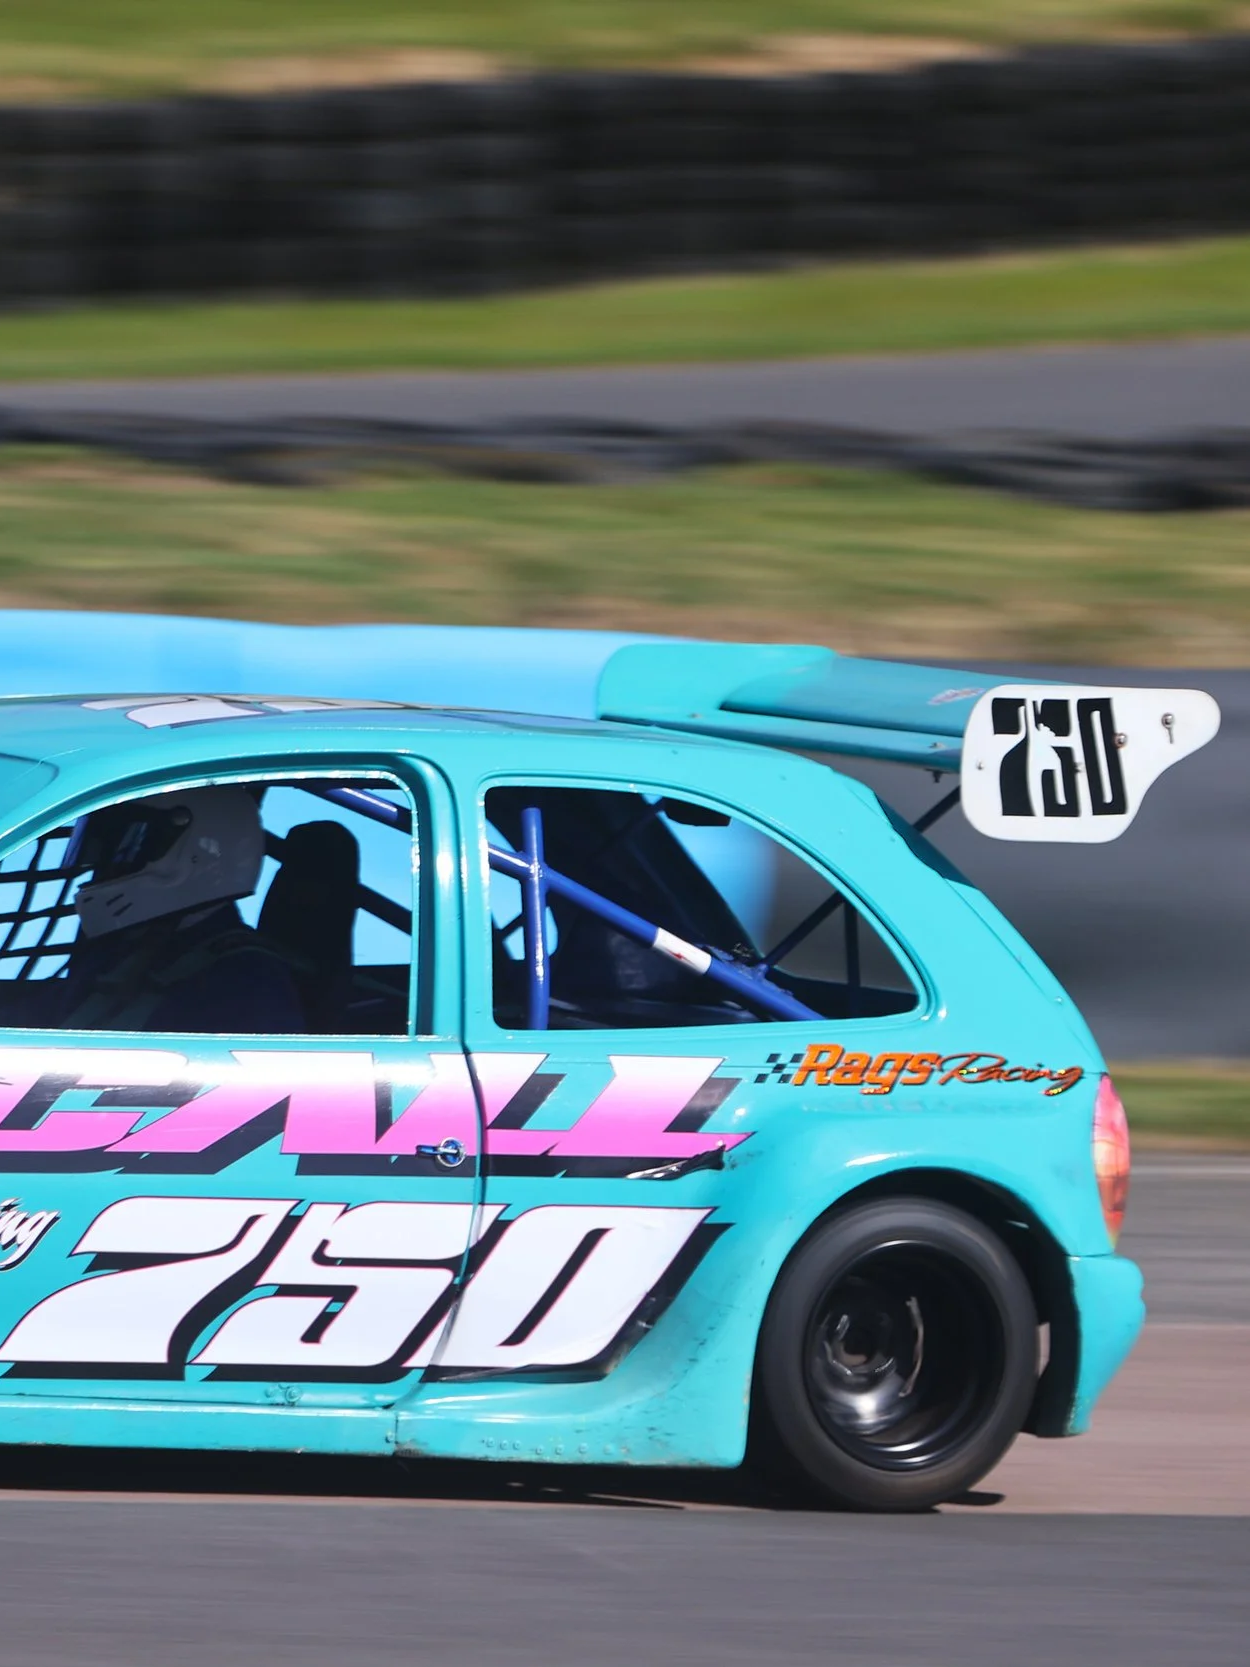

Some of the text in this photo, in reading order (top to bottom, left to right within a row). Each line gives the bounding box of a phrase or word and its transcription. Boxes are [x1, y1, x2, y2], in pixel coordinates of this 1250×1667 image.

[991, 697, 1128, 818] 750
[791, 1043, 1084, 1097] Rags Racing
